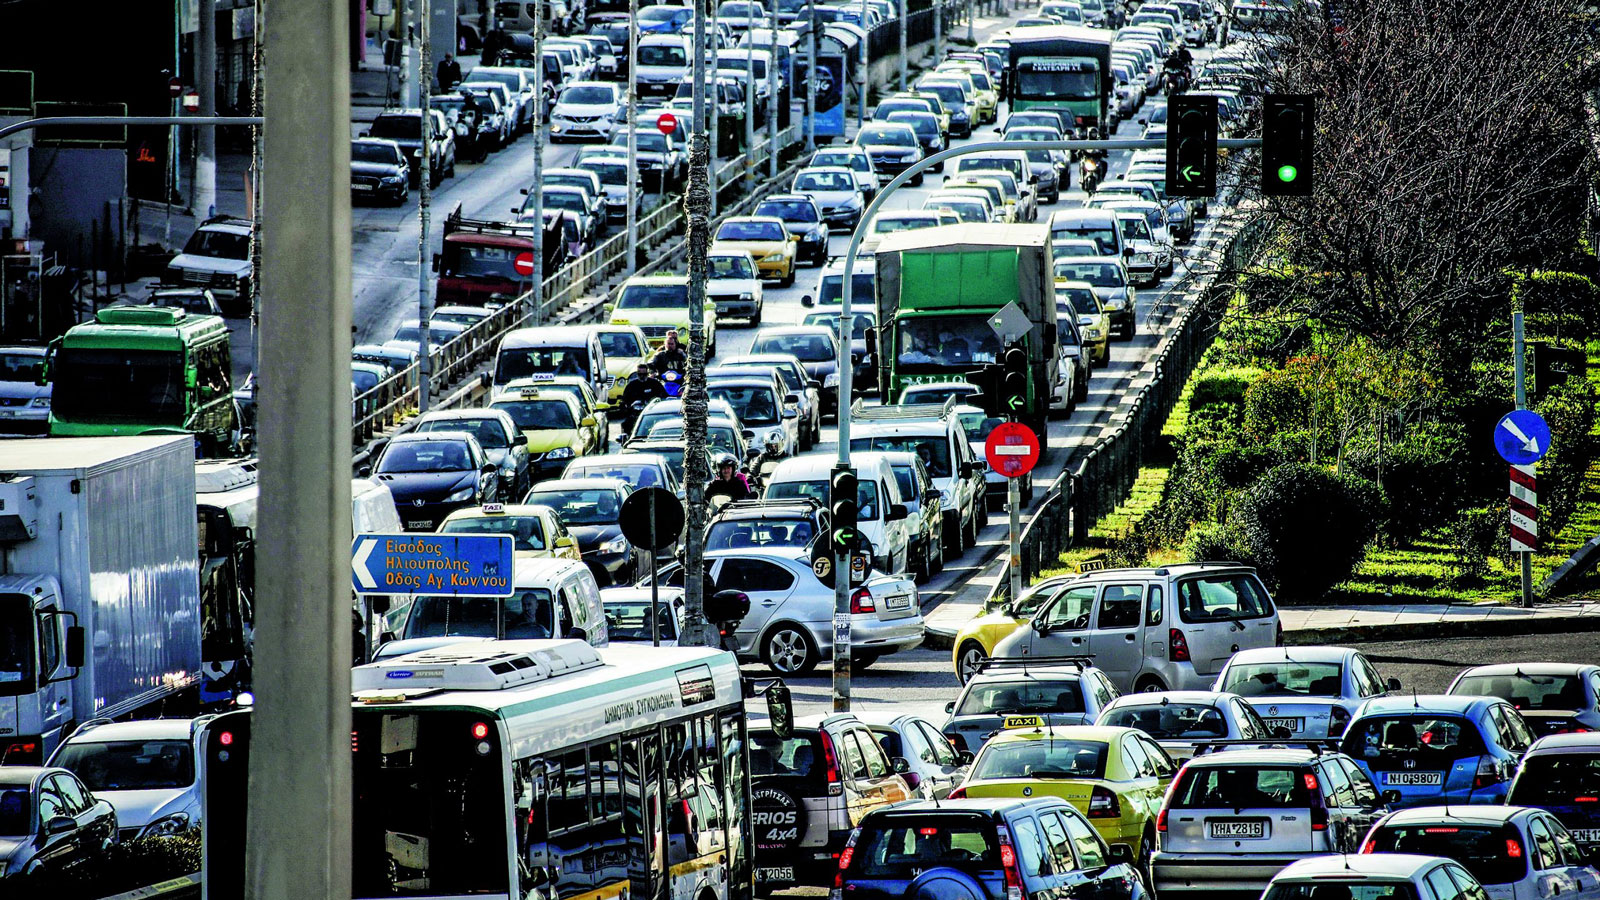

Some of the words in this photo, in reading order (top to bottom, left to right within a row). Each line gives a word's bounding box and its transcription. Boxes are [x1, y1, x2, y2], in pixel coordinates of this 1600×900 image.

[1081, 562, 1101, 571] TAXI
[604, 701, 635, 724] ΔΗΜΟΤΙΚΗ
[636, 692, 675, 716] ΣΥΓΚΟΙΝΩΝΙΑ
[1009, 718, 1036, 726] TAXI
[766, 827, 798, 841] 4x4
